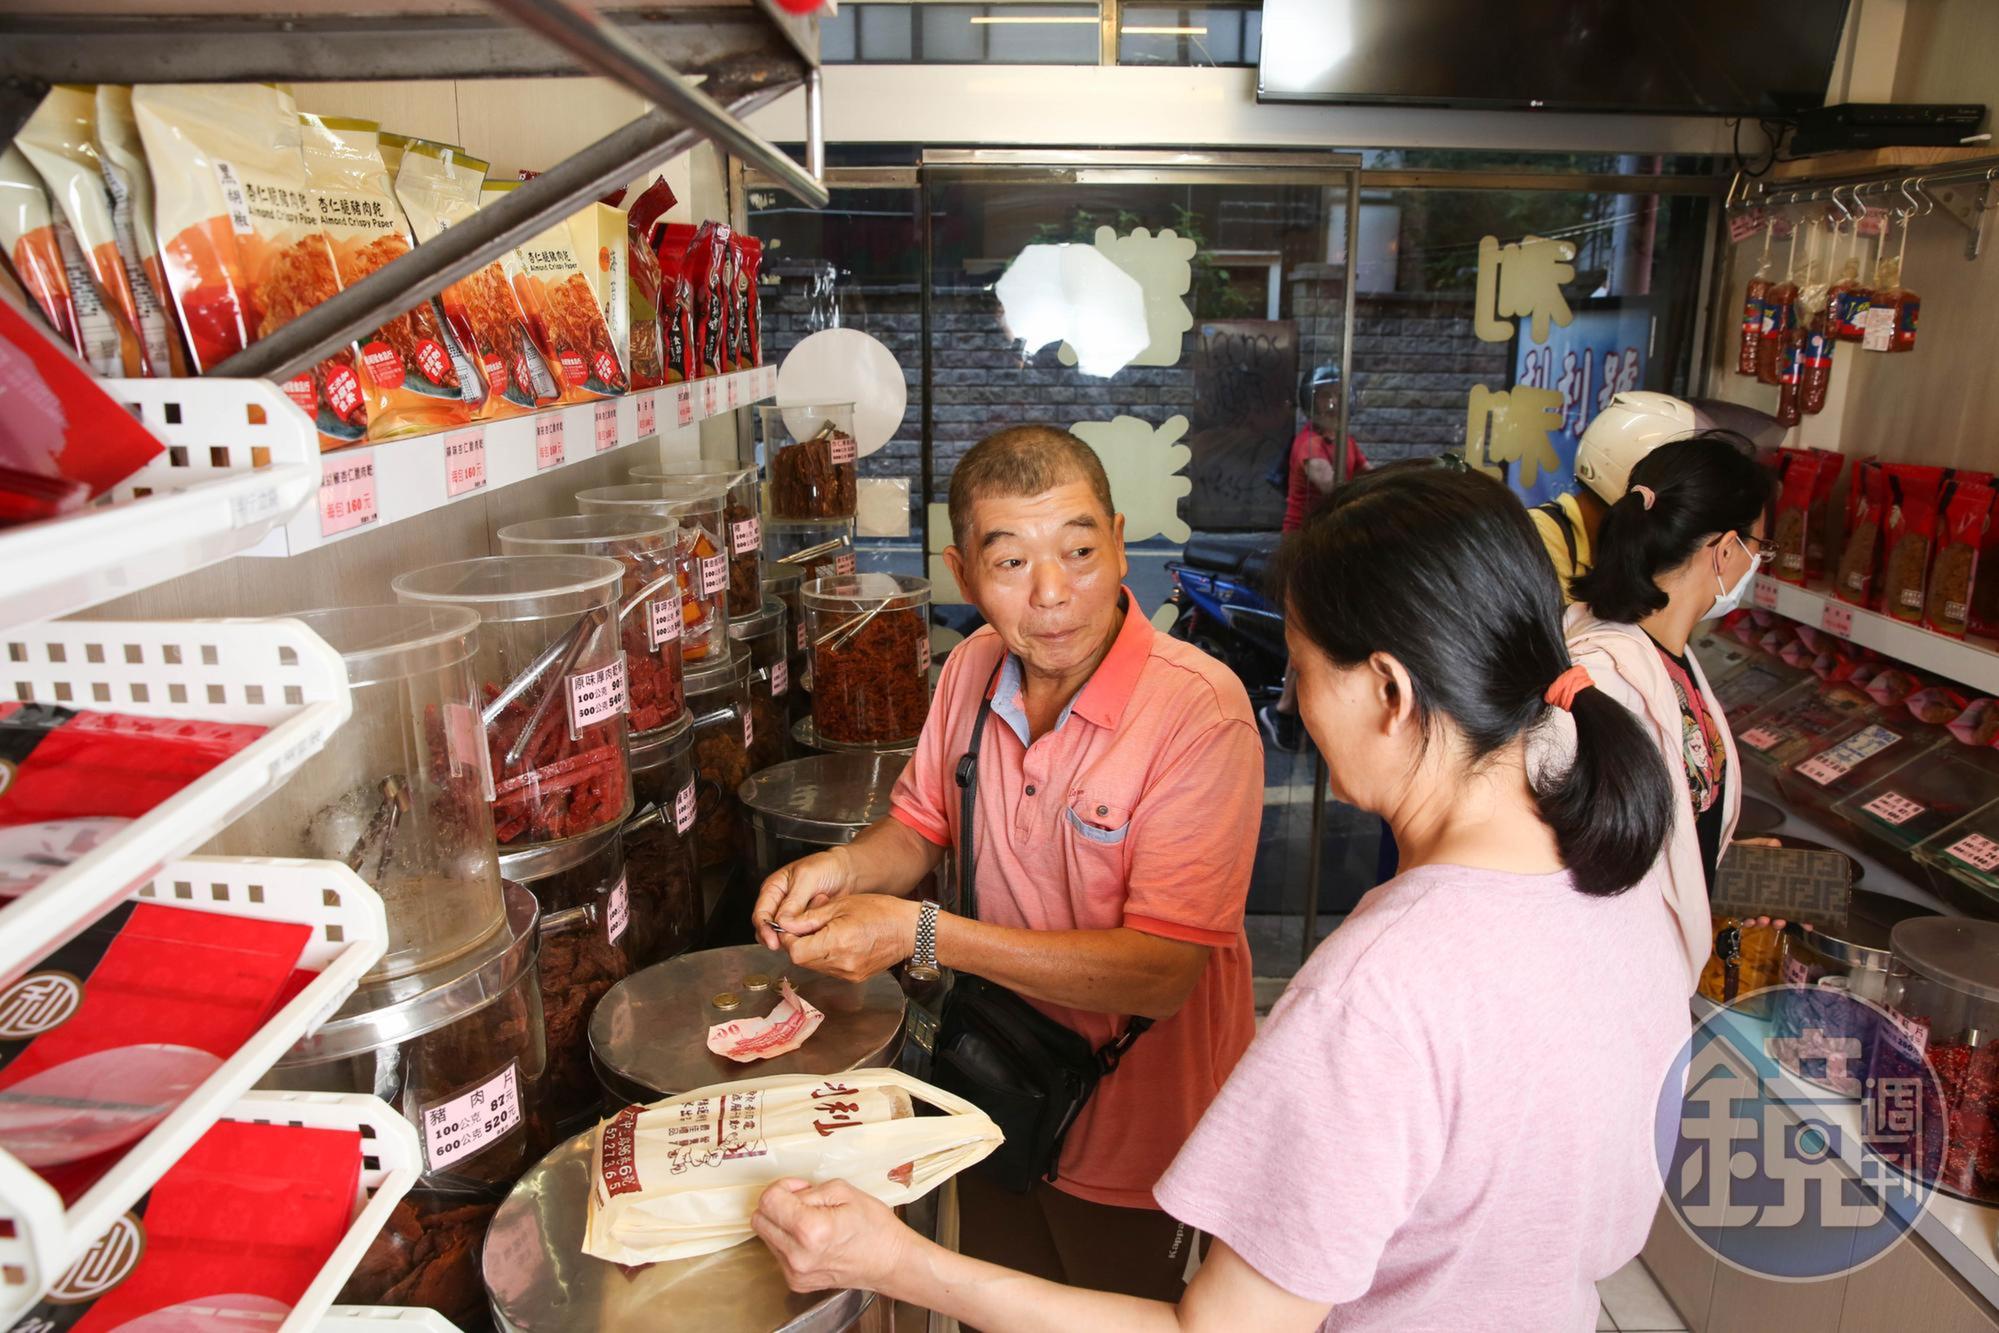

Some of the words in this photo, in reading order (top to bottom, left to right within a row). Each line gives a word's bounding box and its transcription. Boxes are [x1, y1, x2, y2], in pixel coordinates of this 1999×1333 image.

[317, 197, 385, 218] 杏仁脆豬肉乾
[275, 210, 298, 224] Crispy
[299, 212, 318, 226] Pape
[320, 216, 348, 227] Almond
[348, 217, 371, 230] Crispy
[372, 219, 395, 229] Paper
[577, 686, 608, 703] 100公克
[435, 1111, 482, 1140] 100公克
[490, 1088, 515, 1113] 87元
[436, 1128, 483, 1157] 600公克
[484, 1104, 517, 1134] 520元
